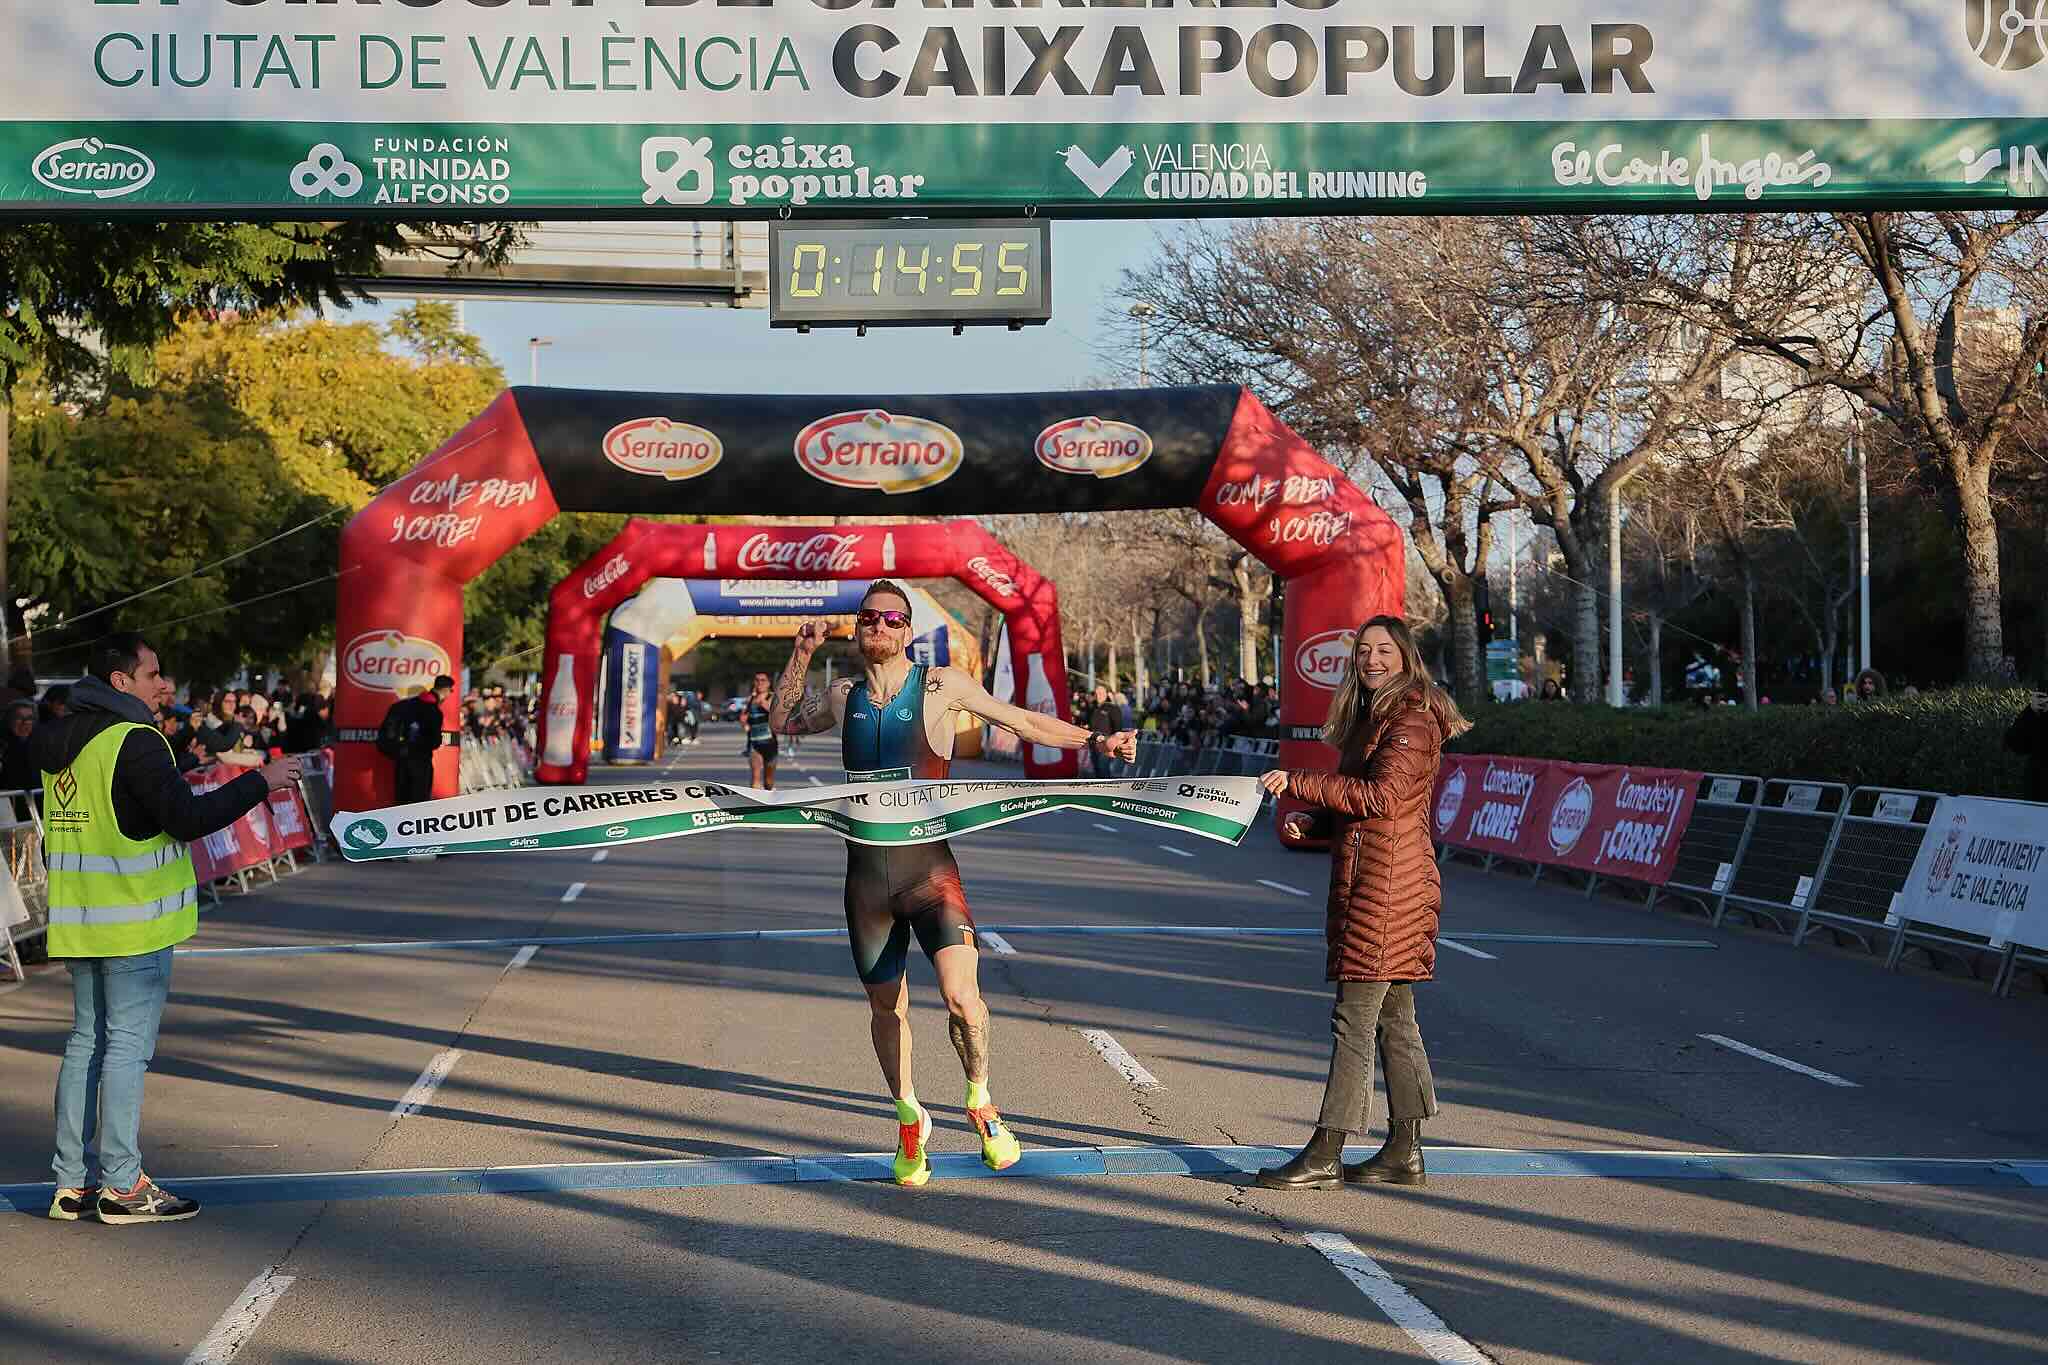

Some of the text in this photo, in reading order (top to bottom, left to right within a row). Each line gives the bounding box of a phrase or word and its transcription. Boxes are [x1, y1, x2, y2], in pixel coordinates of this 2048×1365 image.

[94, 21, 1656, 99] CIUTAT DE VALÈNCIA CAIXA POPULAR
[374, 135, 511, 152] FUNDACIÓN
[728, 136, 855, 169] caixa
[1143, 143, 1271, 171] VALENCIA
[43, 151, 147, 182] Serrano
[372, 157, 511, 181] TRINIDAD
[1551, 142, 1594, 186] El
[1595, 146, 1696, 187] Corte
[373, 183, 511, 204] ALFONSO
[727, 171, 925, 206] popular
[1143, 172, 1427, 200] CIUDAD DEL RUNNING
[789, 243, 1029, 298] 0:14:55
[618, 436, 711, 460] Serrano
[813, 431, 946, 467] Serrano
[1048, 435, 1140, 458] Serrano
[409, 473, 538, 510] COME BIEN
[1215, 473, 1337, 512] COME BIEN
[737, 533, 864, 571] Coca-Cola
[349, 643, 441, 677] Serrano
[879, 784, 940, 808] CIUTAT
[939, 782, 960, 800] DE
[1196, 793, 1241, 807] popular
[1198, 786, 1227, 797] caixa
[397, 807, 497, 836] CIRCUIT
[503, 804, 538, 824] DE
[543, 788, 678, 817] CARRERES
[1119, 801, 1179, 820] INTERSPORT
[1966, 836, 2047, 872] AJUNTAMENT
[1951, 872, 2030, 912] DE VALÈNCIA
